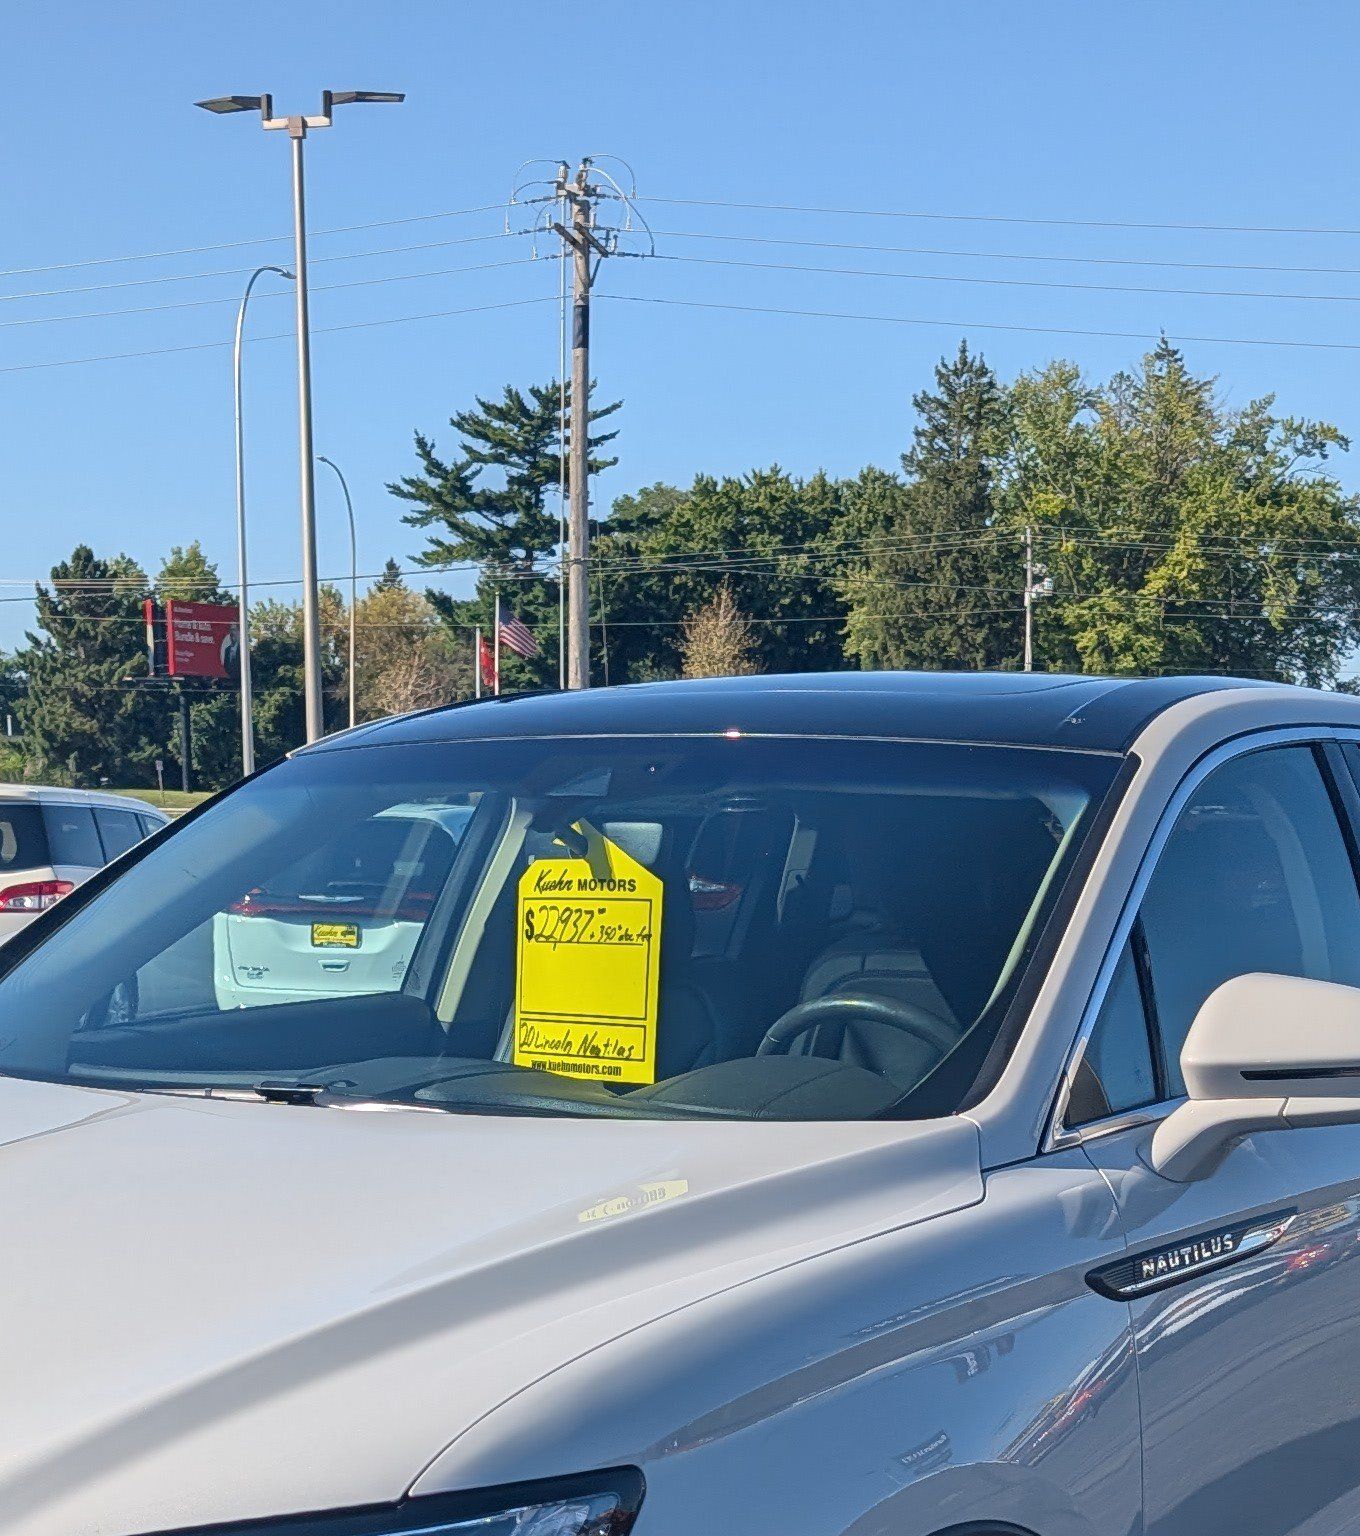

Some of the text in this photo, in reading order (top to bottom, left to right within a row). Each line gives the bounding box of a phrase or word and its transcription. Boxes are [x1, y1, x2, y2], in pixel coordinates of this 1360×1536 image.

[534, 868, 637, 894] Kuehn MOTORS
[531, 1059, 622, 1077] www.kuehnmotors.com
[1141, 1233, 1234, 1279] NAUTILUS
